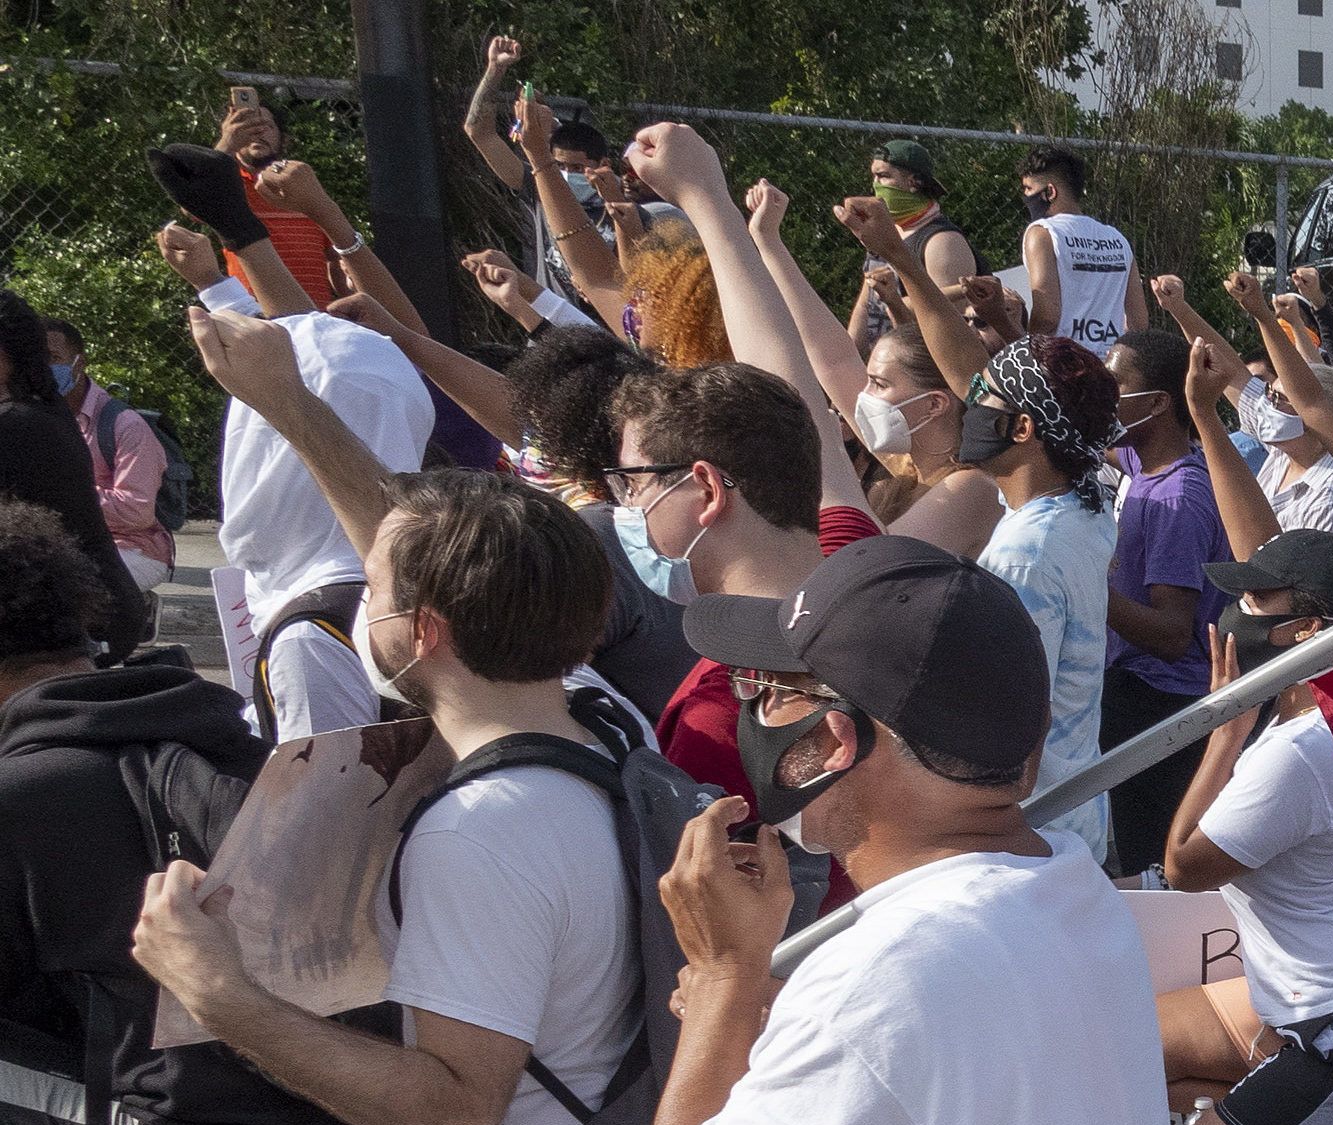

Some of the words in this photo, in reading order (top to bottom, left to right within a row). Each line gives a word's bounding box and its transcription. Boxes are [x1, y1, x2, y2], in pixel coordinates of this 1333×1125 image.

[1065, 236, 1123, 250] UNIFORMS
[1071, 253, 1086, 261] FOR
[1072, 319, 1119, 342] HGA
